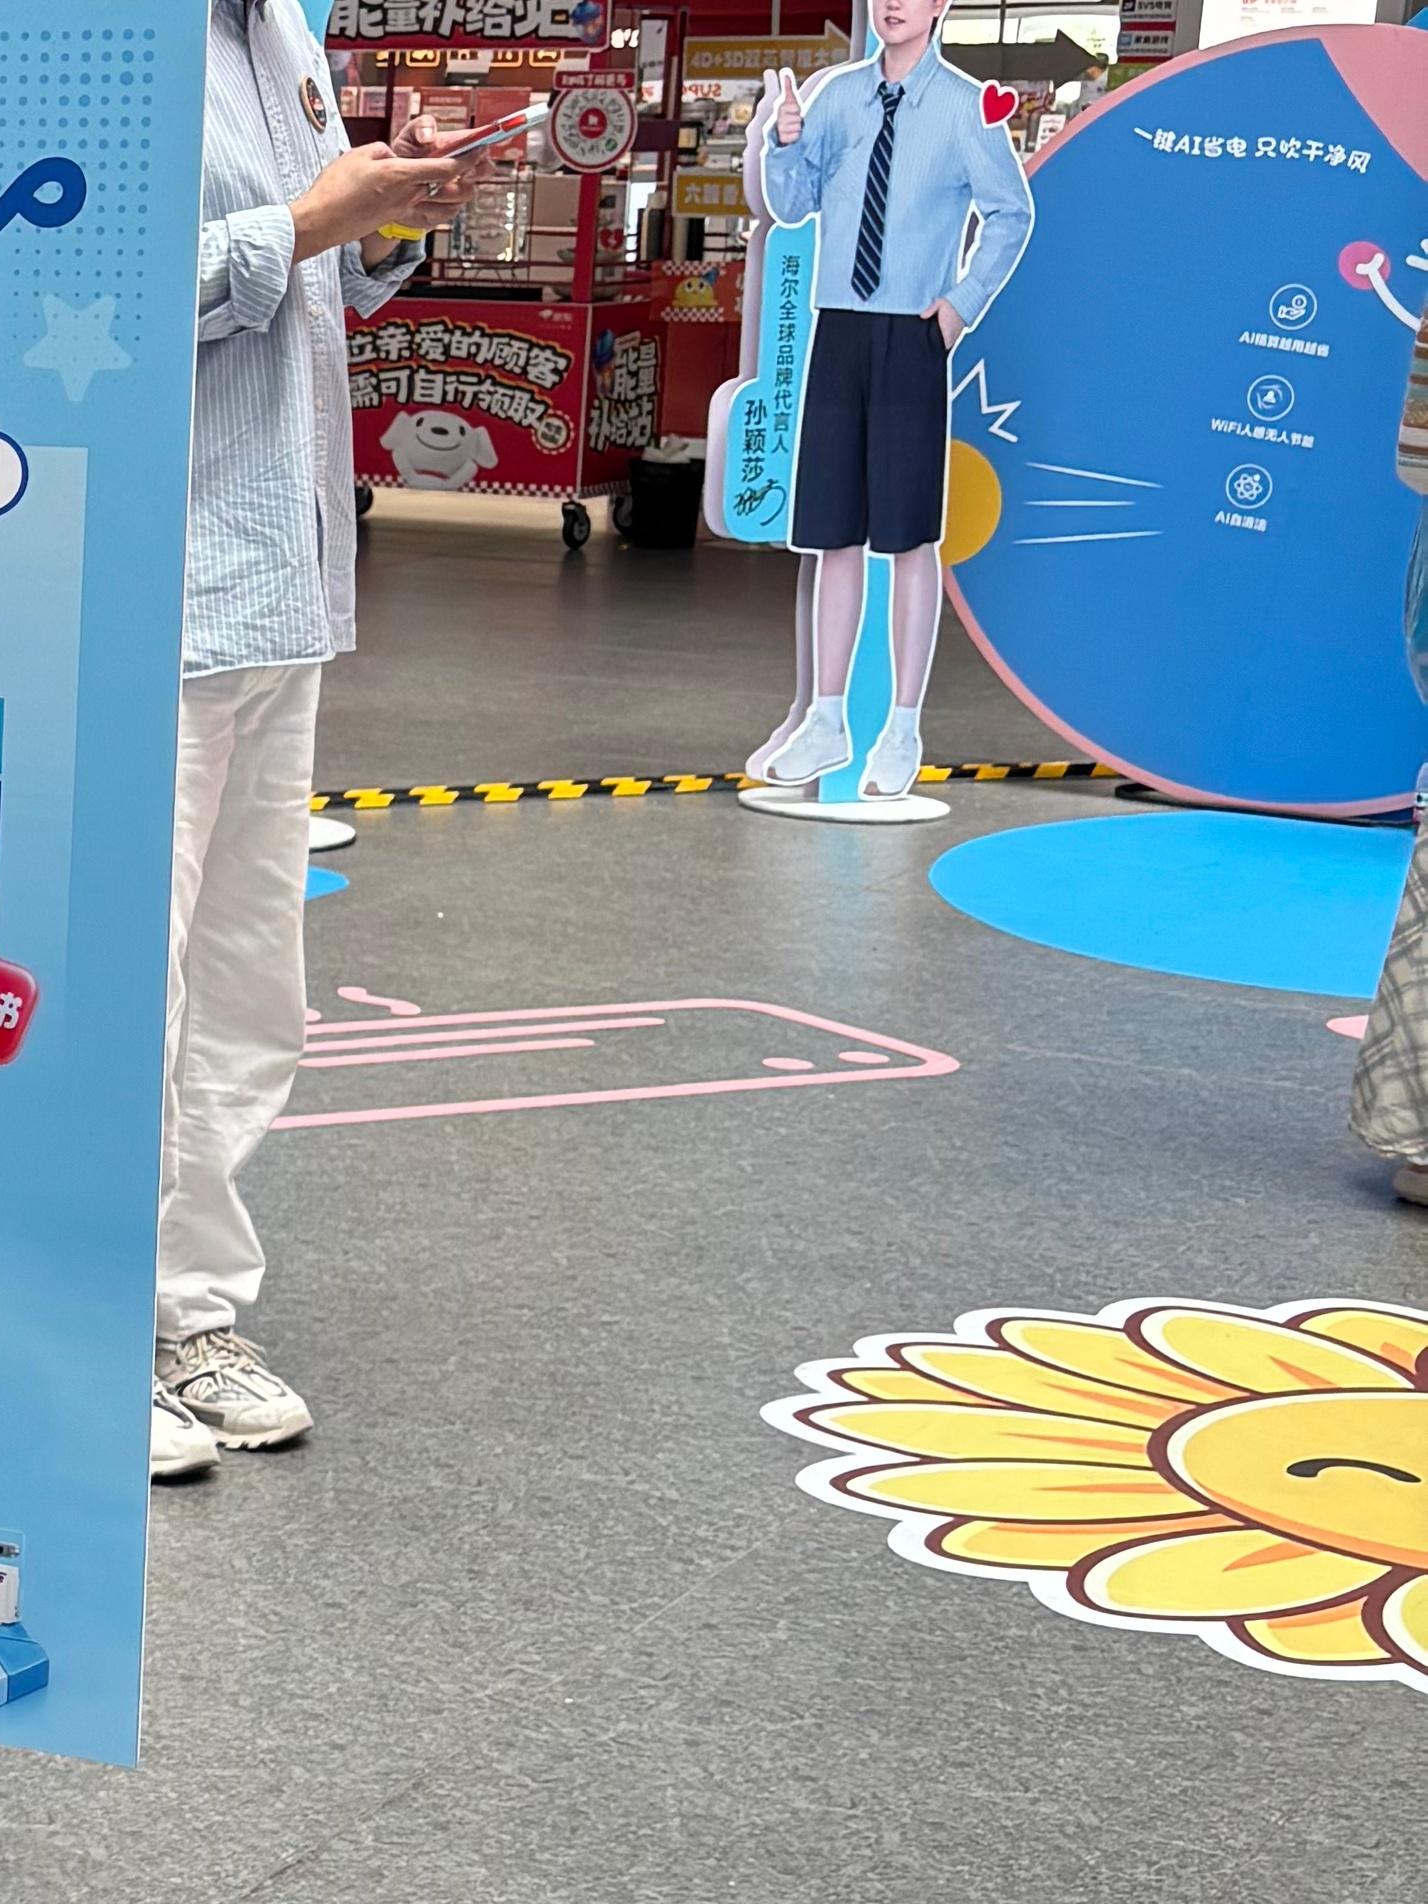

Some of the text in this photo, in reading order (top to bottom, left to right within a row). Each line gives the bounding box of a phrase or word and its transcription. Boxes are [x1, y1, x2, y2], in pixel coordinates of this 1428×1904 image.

[1134, 127, 1371, 174] 一键AI省电 只吹干净风
[771, 255, 800, 454] 海尔全球品牌代言人
[741, 399, 767, 483] 孙颖莎
